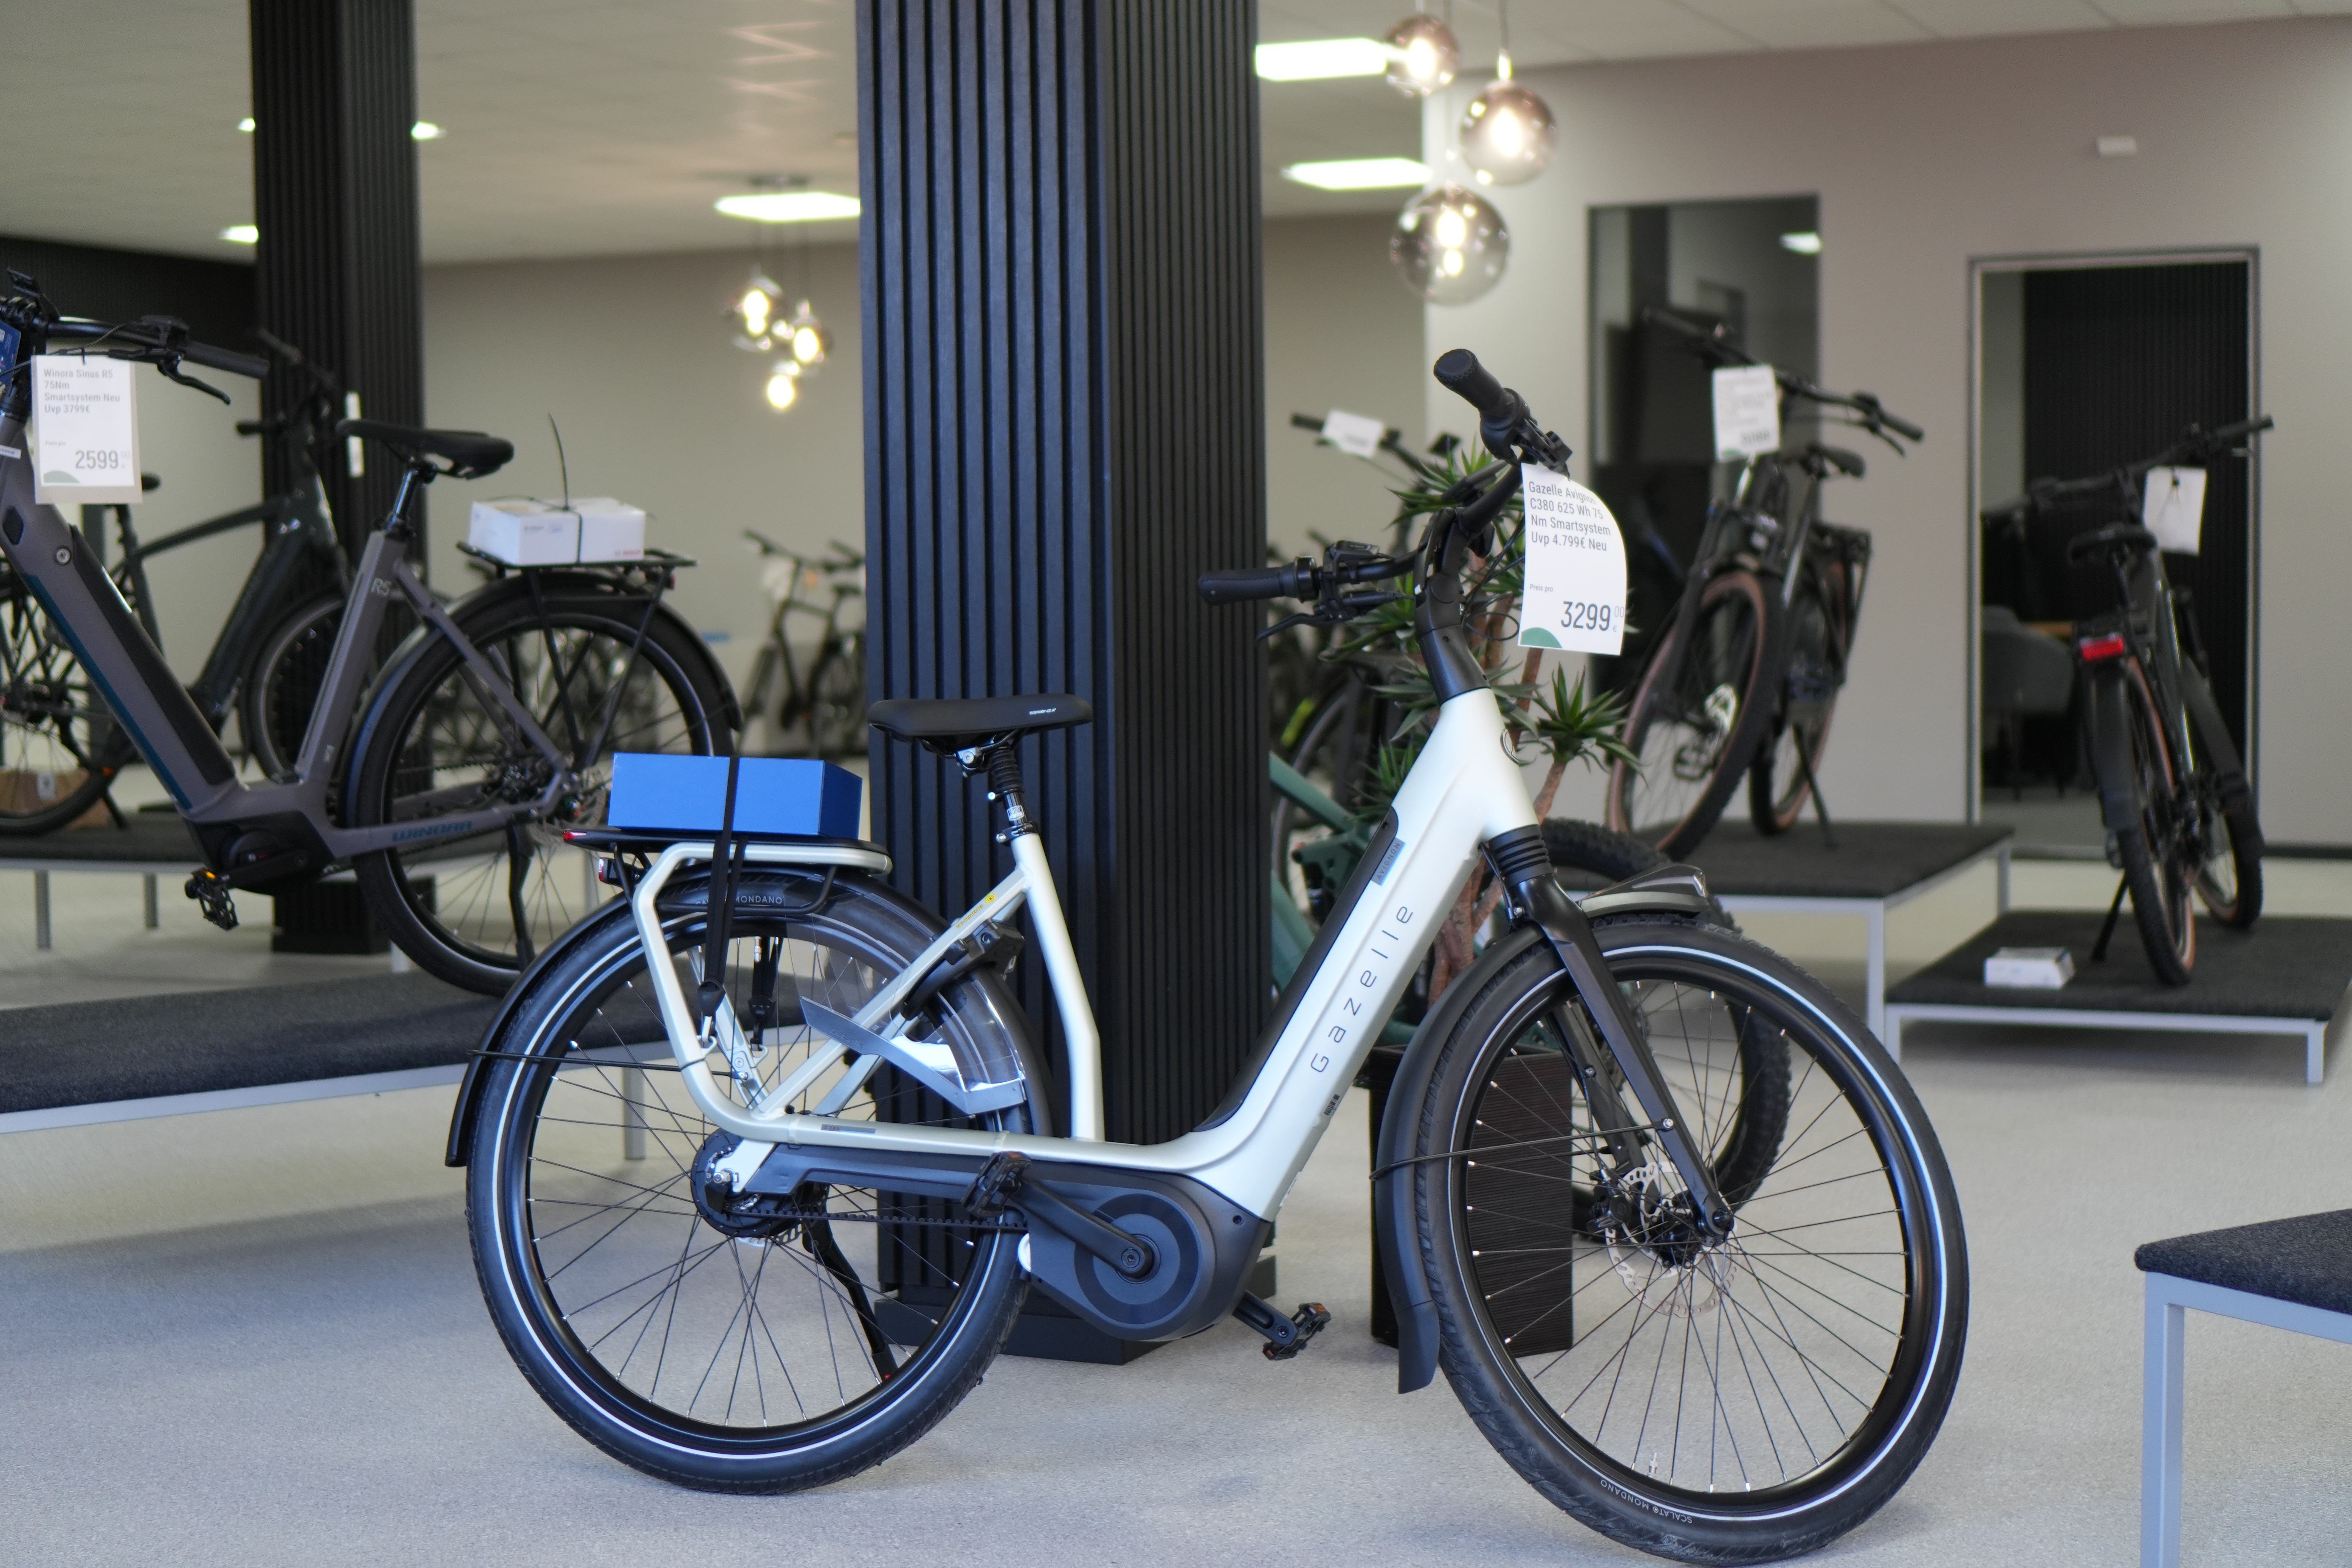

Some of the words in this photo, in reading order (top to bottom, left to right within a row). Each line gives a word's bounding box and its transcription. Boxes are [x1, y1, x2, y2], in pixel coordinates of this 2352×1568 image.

[44, 369, 73, 378] Winora
[77, 370, 99, 378] Sinus
[44, 381, 70, 389] 75Nm
[44, 393, 101, 403] Smartsystem
[104, 393, 120, 402] Neu
[44, 405, 61, 414] Uvp
[64, 405, 90, 413] 3799€
[75, 450, 119, 469] 2599
[1529, 481, 1563, 496] Gazelle
[1566, 488, 1597, 505] Avignon
[1530, 498, 1554, 511] C380
[1558, 502, 1574, 514] 625
[1576, 504, 1591, 517] Wh
[1592, 508, 1603, 519] 75
[1531, 514, 1547, 527] Nm
[1550, 517, 1611, 536] Smartsystem
[1532, 531, 1549, 547] Uvp
[1552, 534, 1585, 548] 4.799€
[1589, 538, 1607, 551] Neu
[1561, 601, 1611, 631] 3299
[1614, 606, 1625, 618] 00
[1377, 842, 1400, 880] AVIGNON
[1310, 906, 1413, 1072] Gazelle
[1600, 1479, 1649, 1510] MONDANO
[1652, 1506, 1693, 1524] SCALATO
